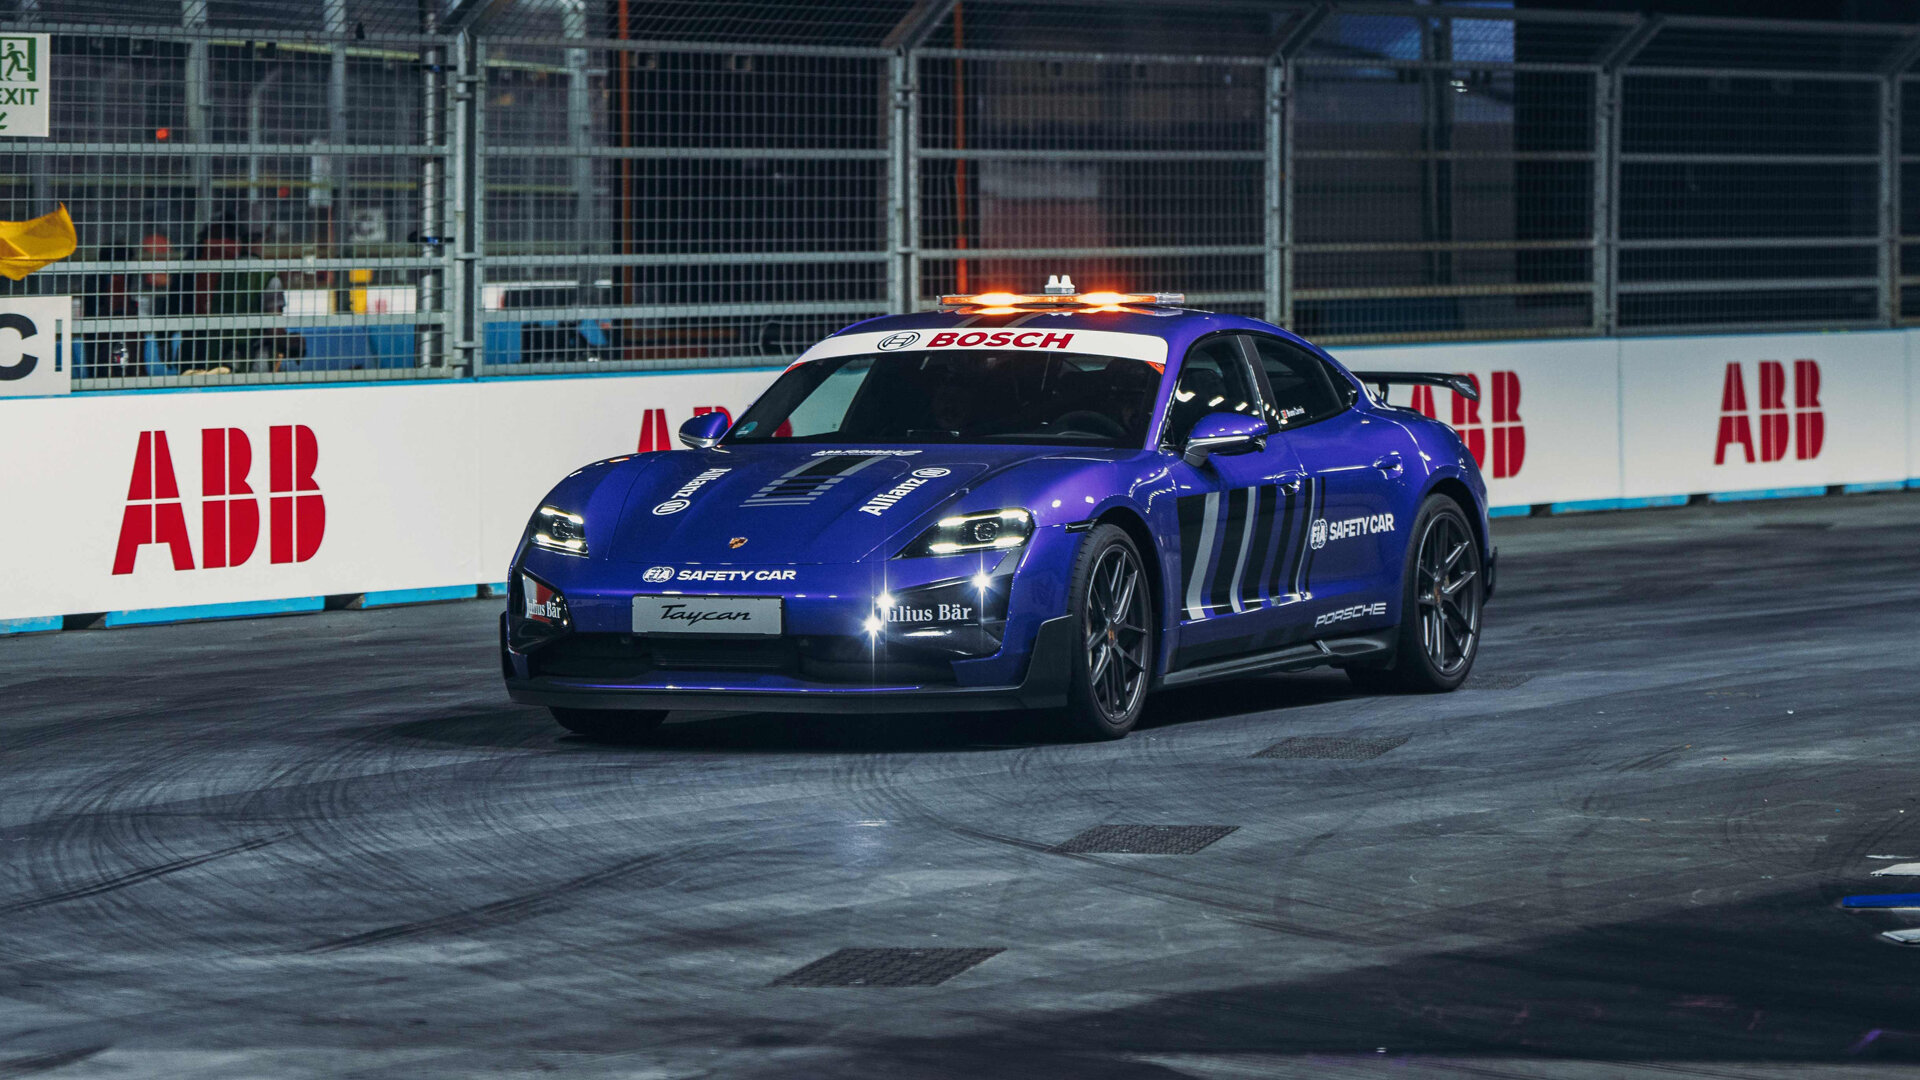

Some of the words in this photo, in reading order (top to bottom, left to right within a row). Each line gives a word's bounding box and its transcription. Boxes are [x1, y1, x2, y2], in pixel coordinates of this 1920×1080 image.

[0, 88, 39, 105] XIT
[926, 332, 1075, 349] BOSCH
[1411, 370, 1526, 479] BB
[1714, 359, 1825, 465] ABB
[671, 468, 732, 499] Allianz
[858, 477, 928, 516] Allianz
[112, 425, 326, 575] ABB
[1329, 516, 1369, 540] SAFETY
[1370, 513, 1395, 533] CAR
[676, 570, 754, 581] SAFETY
[755, 570, 797, 580] CAR
[546, 600, 562, 618] Bär
[661, 604, 751, 626] Taycan
[938, 604, 972, 620] Bär
[1314, 602, 1387, 628] PORSCHE
